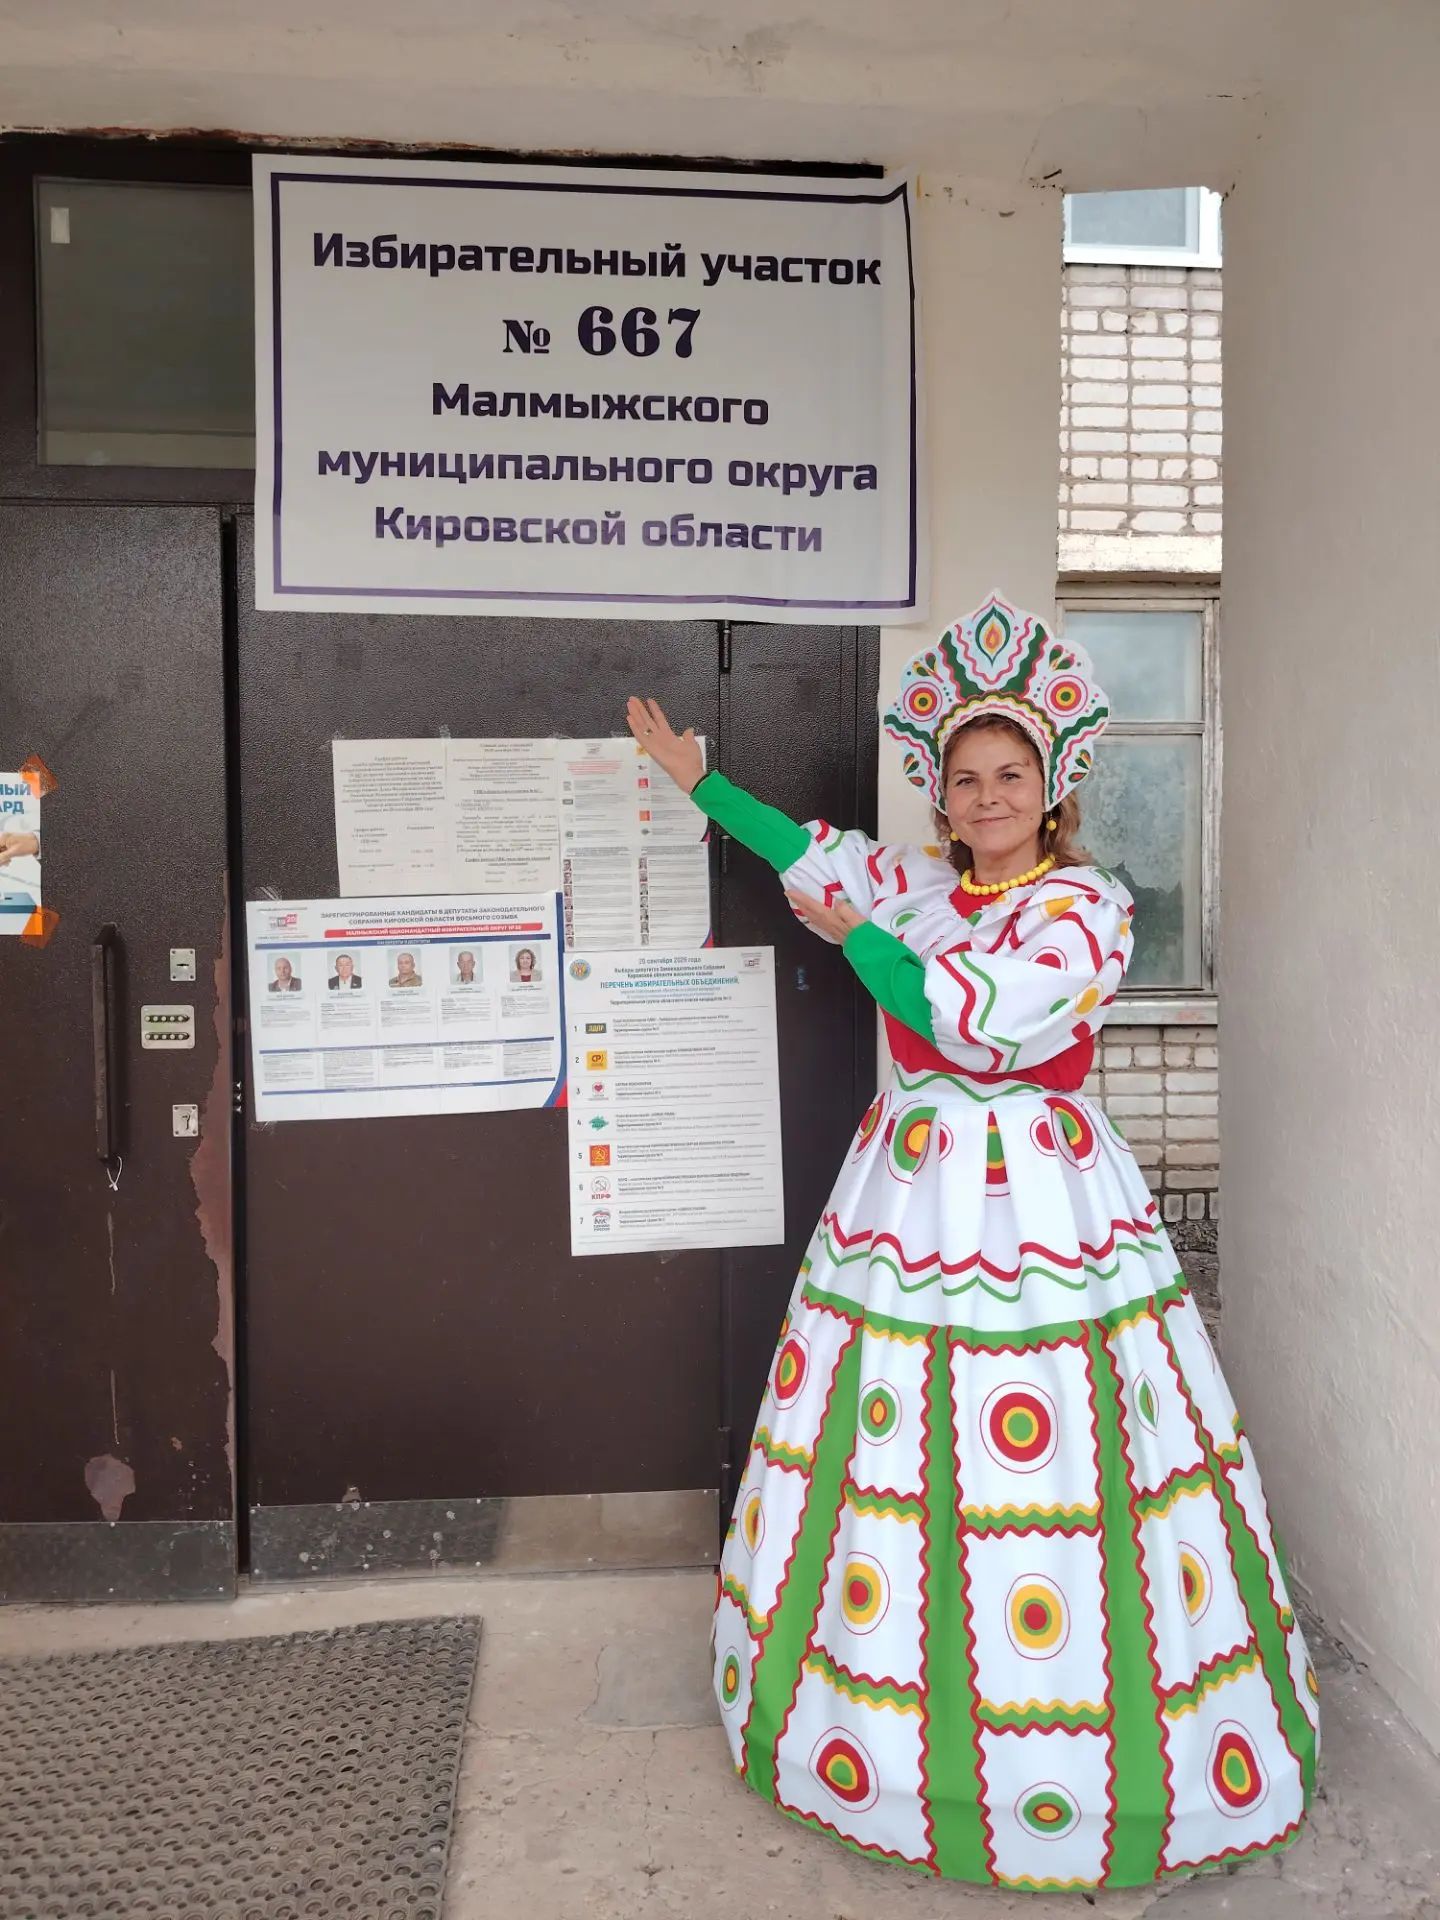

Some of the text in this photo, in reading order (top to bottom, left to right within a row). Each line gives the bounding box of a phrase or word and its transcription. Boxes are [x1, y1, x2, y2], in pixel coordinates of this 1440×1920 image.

[313, 232, 882, 287] Избирательный участок
[502, 306, 702, 359] № 667
[432, 382, 769, 426] Малмыжского
[317, 449, 878, 497] муниципального округа
[375, 507, 823, 553] Кировской области
[0, 801, 25, 815] РД
[600, 980, 634, 989] ПЕРЕЧЕНЬ
[634, 978, 690, 988] ИЗБИРАТЕЛЬНЫХ
